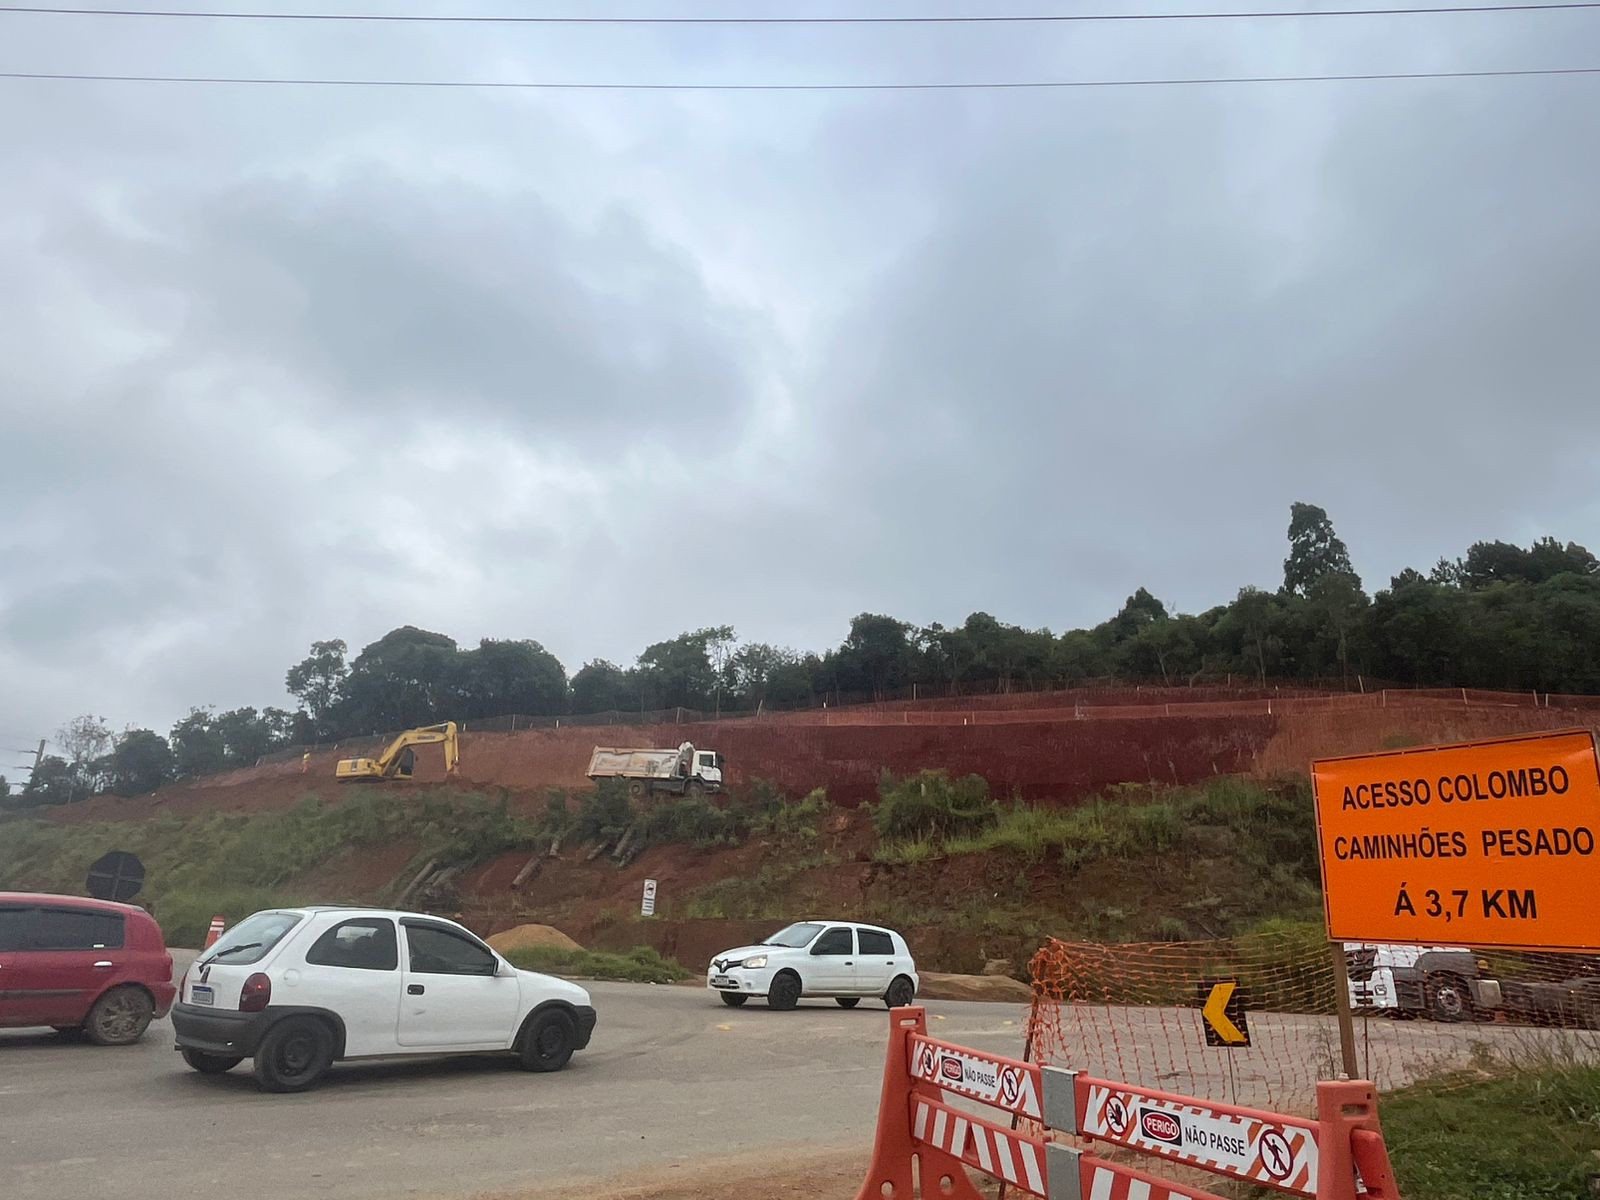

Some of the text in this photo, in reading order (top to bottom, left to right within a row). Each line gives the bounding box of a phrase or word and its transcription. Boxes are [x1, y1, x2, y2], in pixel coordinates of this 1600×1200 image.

[1342, 765, 1569, 810] ACESSO COLOMBO
[1334, 826, 1594, 860] CAMINHÕES PESADO
[1394, 882, 1537, 922] Á 3,7 KM
[1146, 1118, 1177, 1136] PERIGO
[1185, 1125, 1246, 1157] NÃO PASSE
